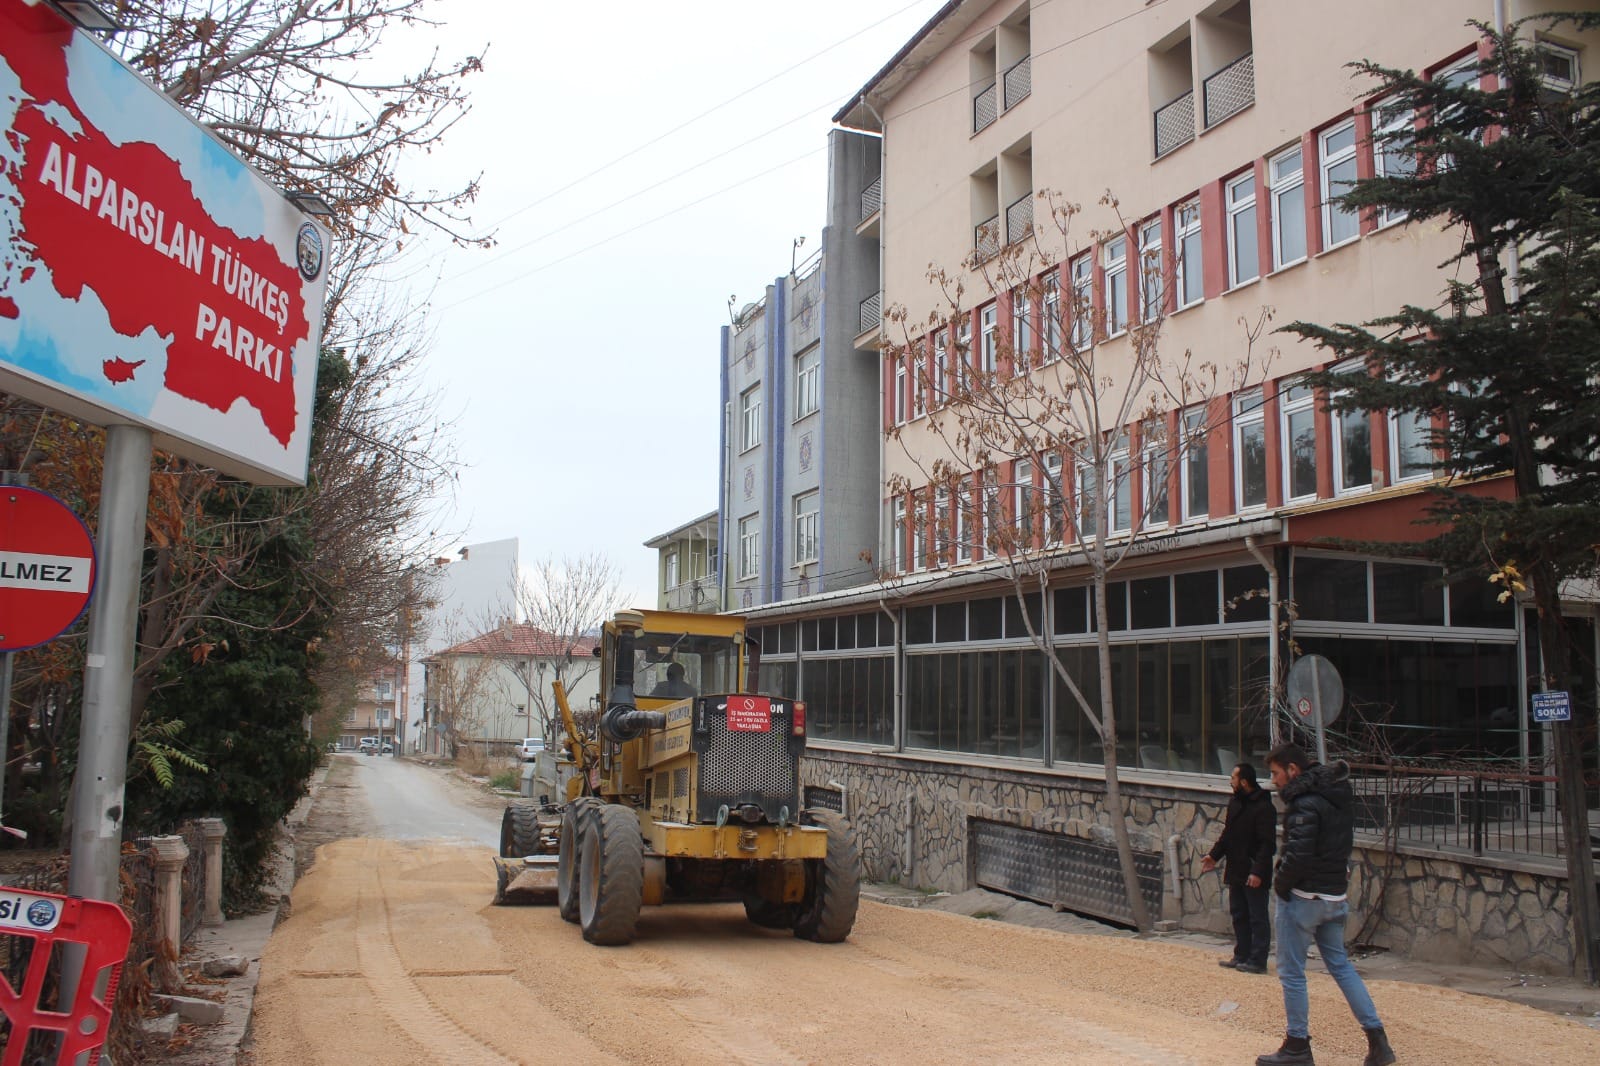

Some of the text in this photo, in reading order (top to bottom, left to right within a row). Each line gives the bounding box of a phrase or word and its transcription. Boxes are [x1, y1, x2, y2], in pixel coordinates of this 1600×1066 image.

[39, 141, 205, 275] ALPARSLAN
[211, 246, 289, 335] TÜRKEŞ
[195, 302, 283, 383] PARKI
[1, 562, 72, 582] LMEZ
[1537, 708, 1567, 717] SOKAK
